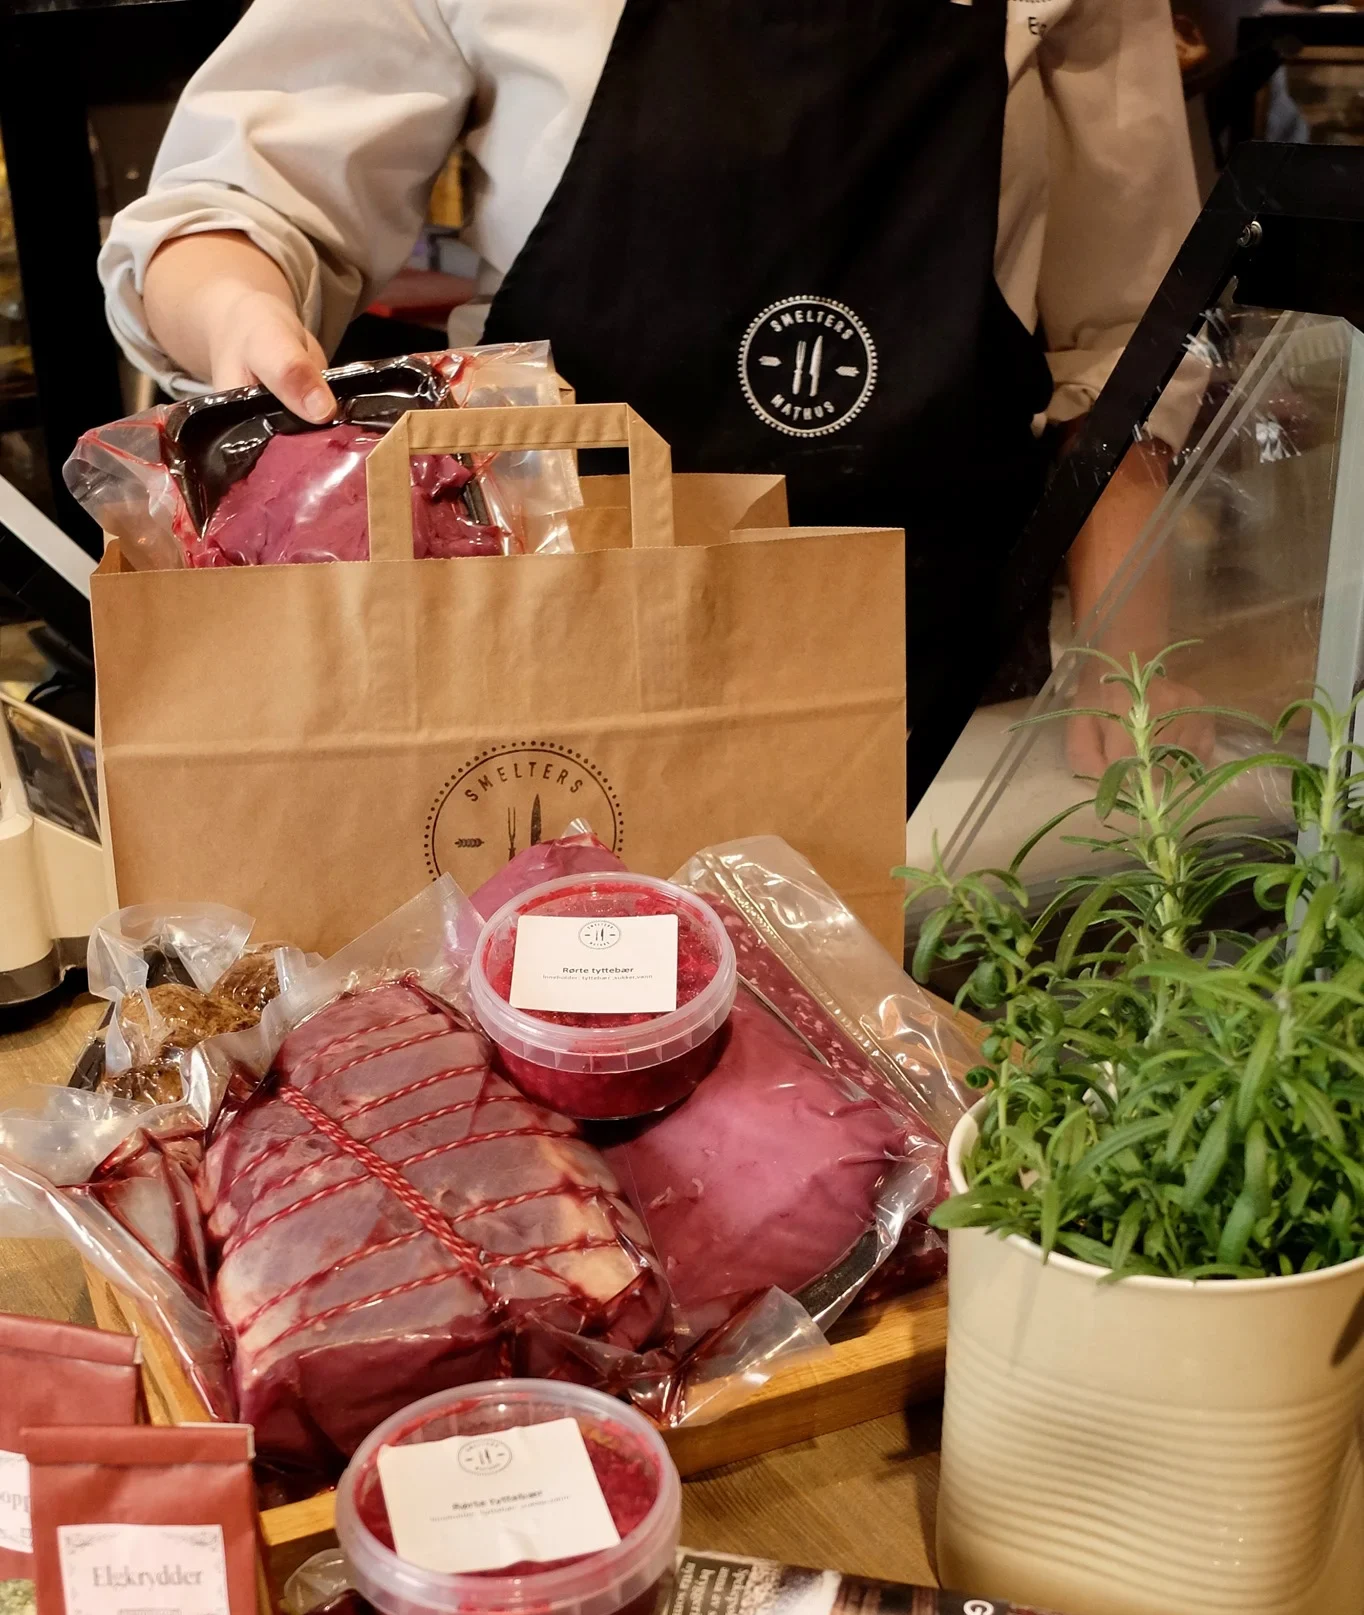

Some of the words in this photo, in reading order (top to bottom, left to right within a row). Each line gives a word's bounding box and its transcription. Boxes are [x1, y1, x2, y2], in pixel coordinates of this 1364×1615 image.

[769, 309, 854, 340] SMELTERS
[770, 394, 835, 421] MATHUS
[464, 761, 583, 802] SMELTERS
[591, 967, 634, 975] tyttebær
[92, 1564, 203, 1591] Elgkrydder
